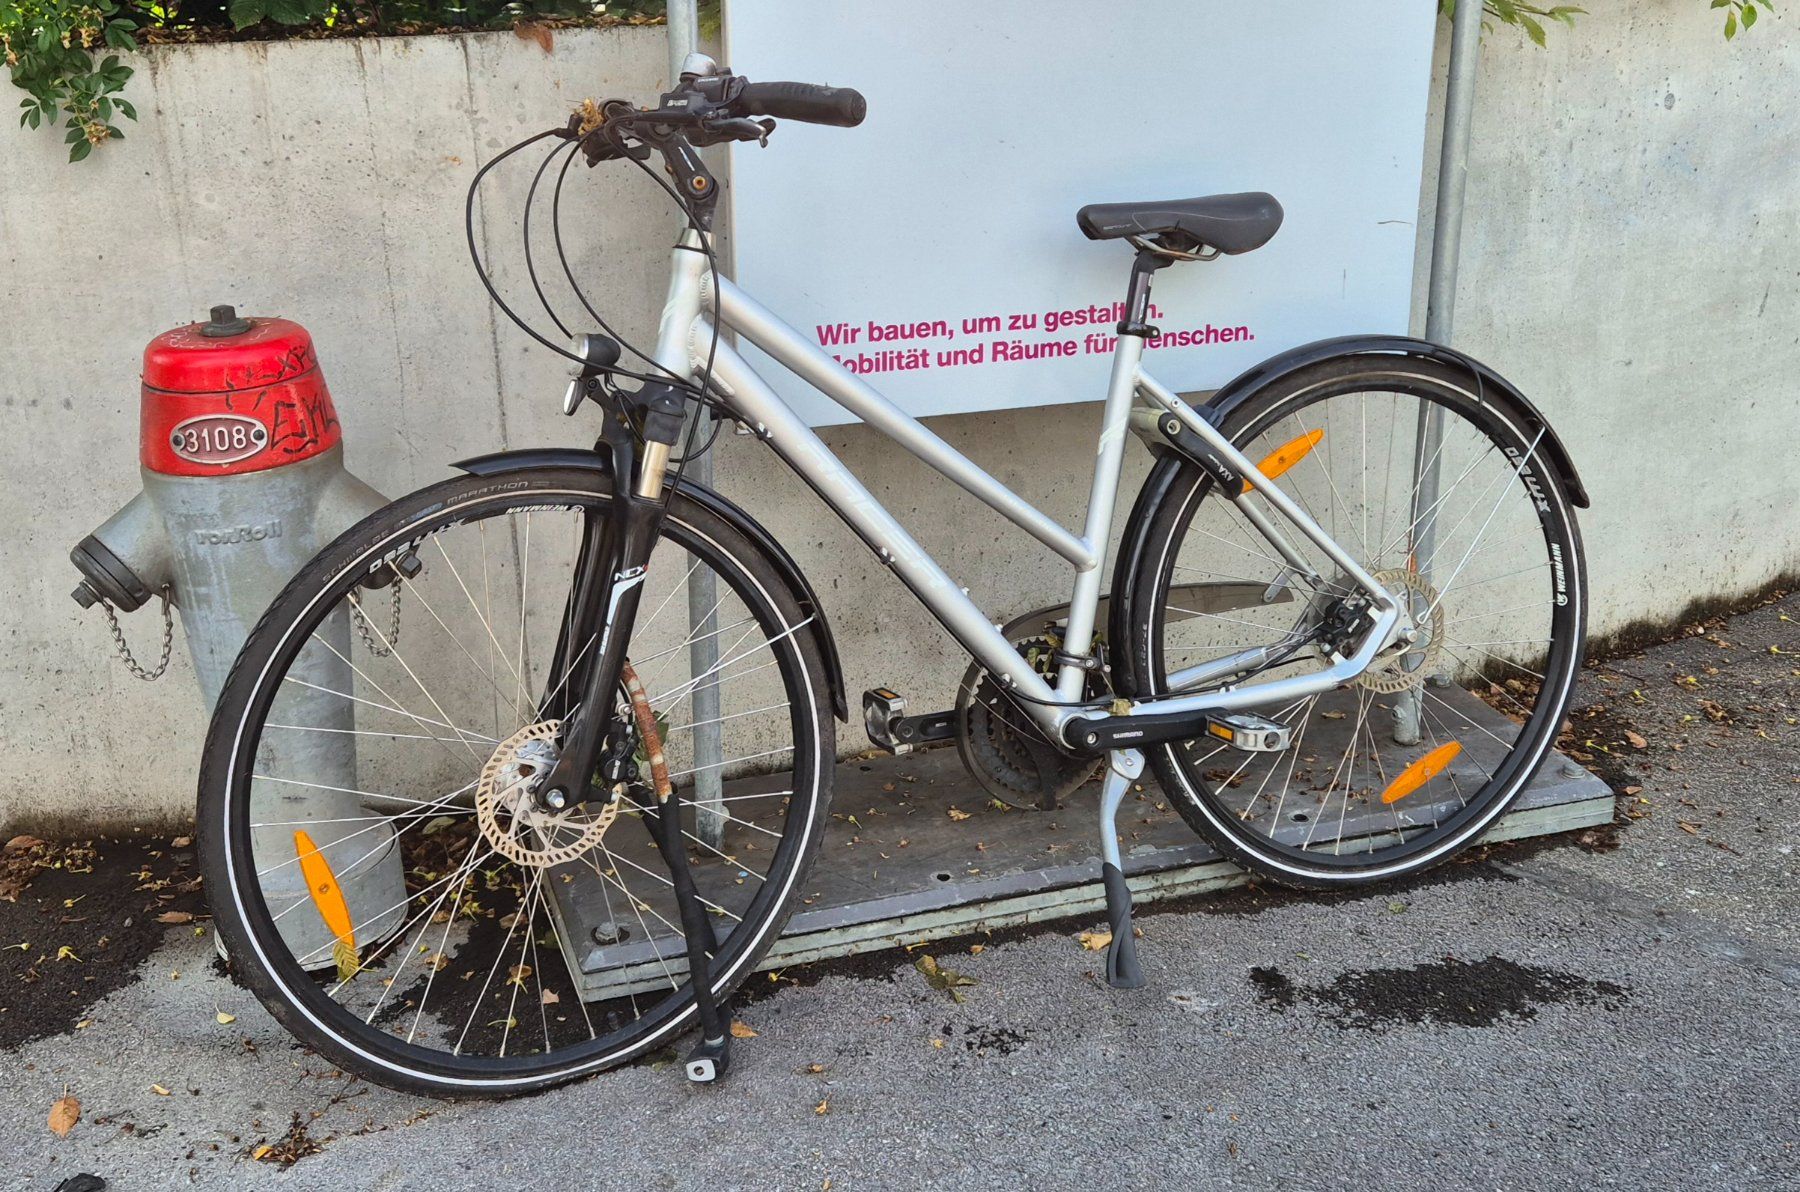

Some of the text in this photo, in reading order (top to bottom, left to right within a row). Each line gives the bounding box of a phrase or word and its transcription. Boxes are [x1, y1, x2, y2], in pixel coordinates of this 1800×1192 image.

[816, 323, 862, 346] Wir
[868, 321, 954, 342] bauen,
[962, 316, 1003, 336] um
[1009, 313, 1038, 331] zu
[1044, 303, 1164, 334] gestaltn.
[832, 324, 1255, 375] obilität und Räume für enschen.
[184, 424, 248, 453] 3108
[446, 480, 530, 505] MARATHON
[1550, 542, 1566, 593] WEINMANN
[1112, 730, 1144, 740] SHIMANO
